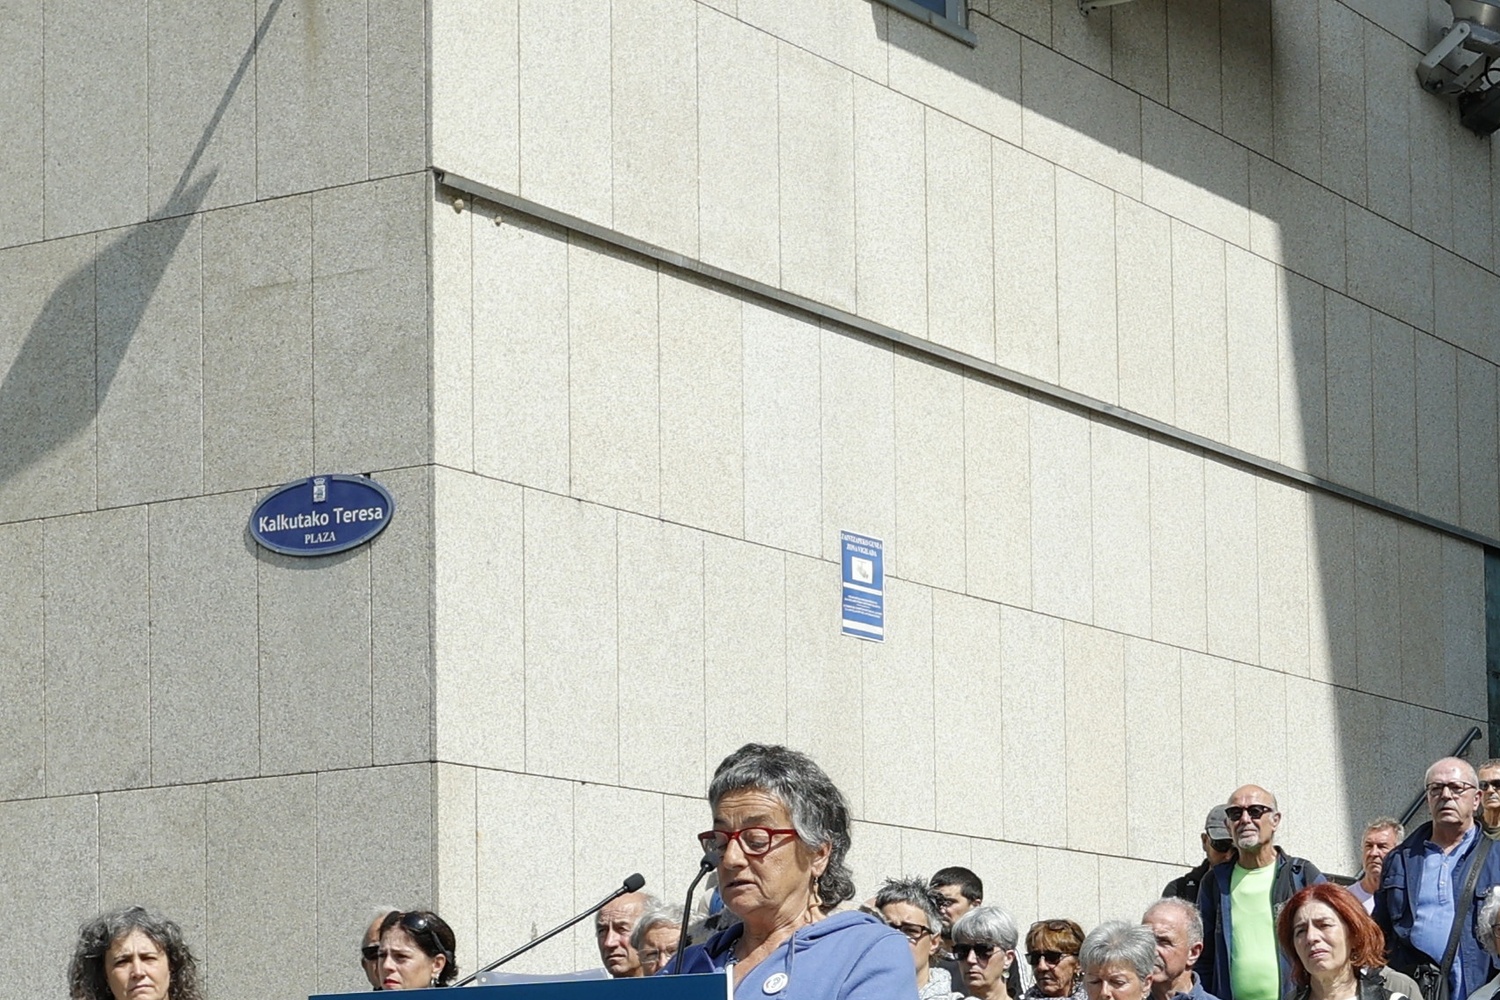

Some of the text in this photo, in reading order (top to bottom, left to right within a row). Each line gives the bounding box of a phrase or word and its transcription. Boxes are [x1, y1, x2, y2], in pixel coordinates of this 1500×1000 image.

[259, 507, 383, 533] Kalkutako Teresa
[304, 531, 336, 544] PLAZA
